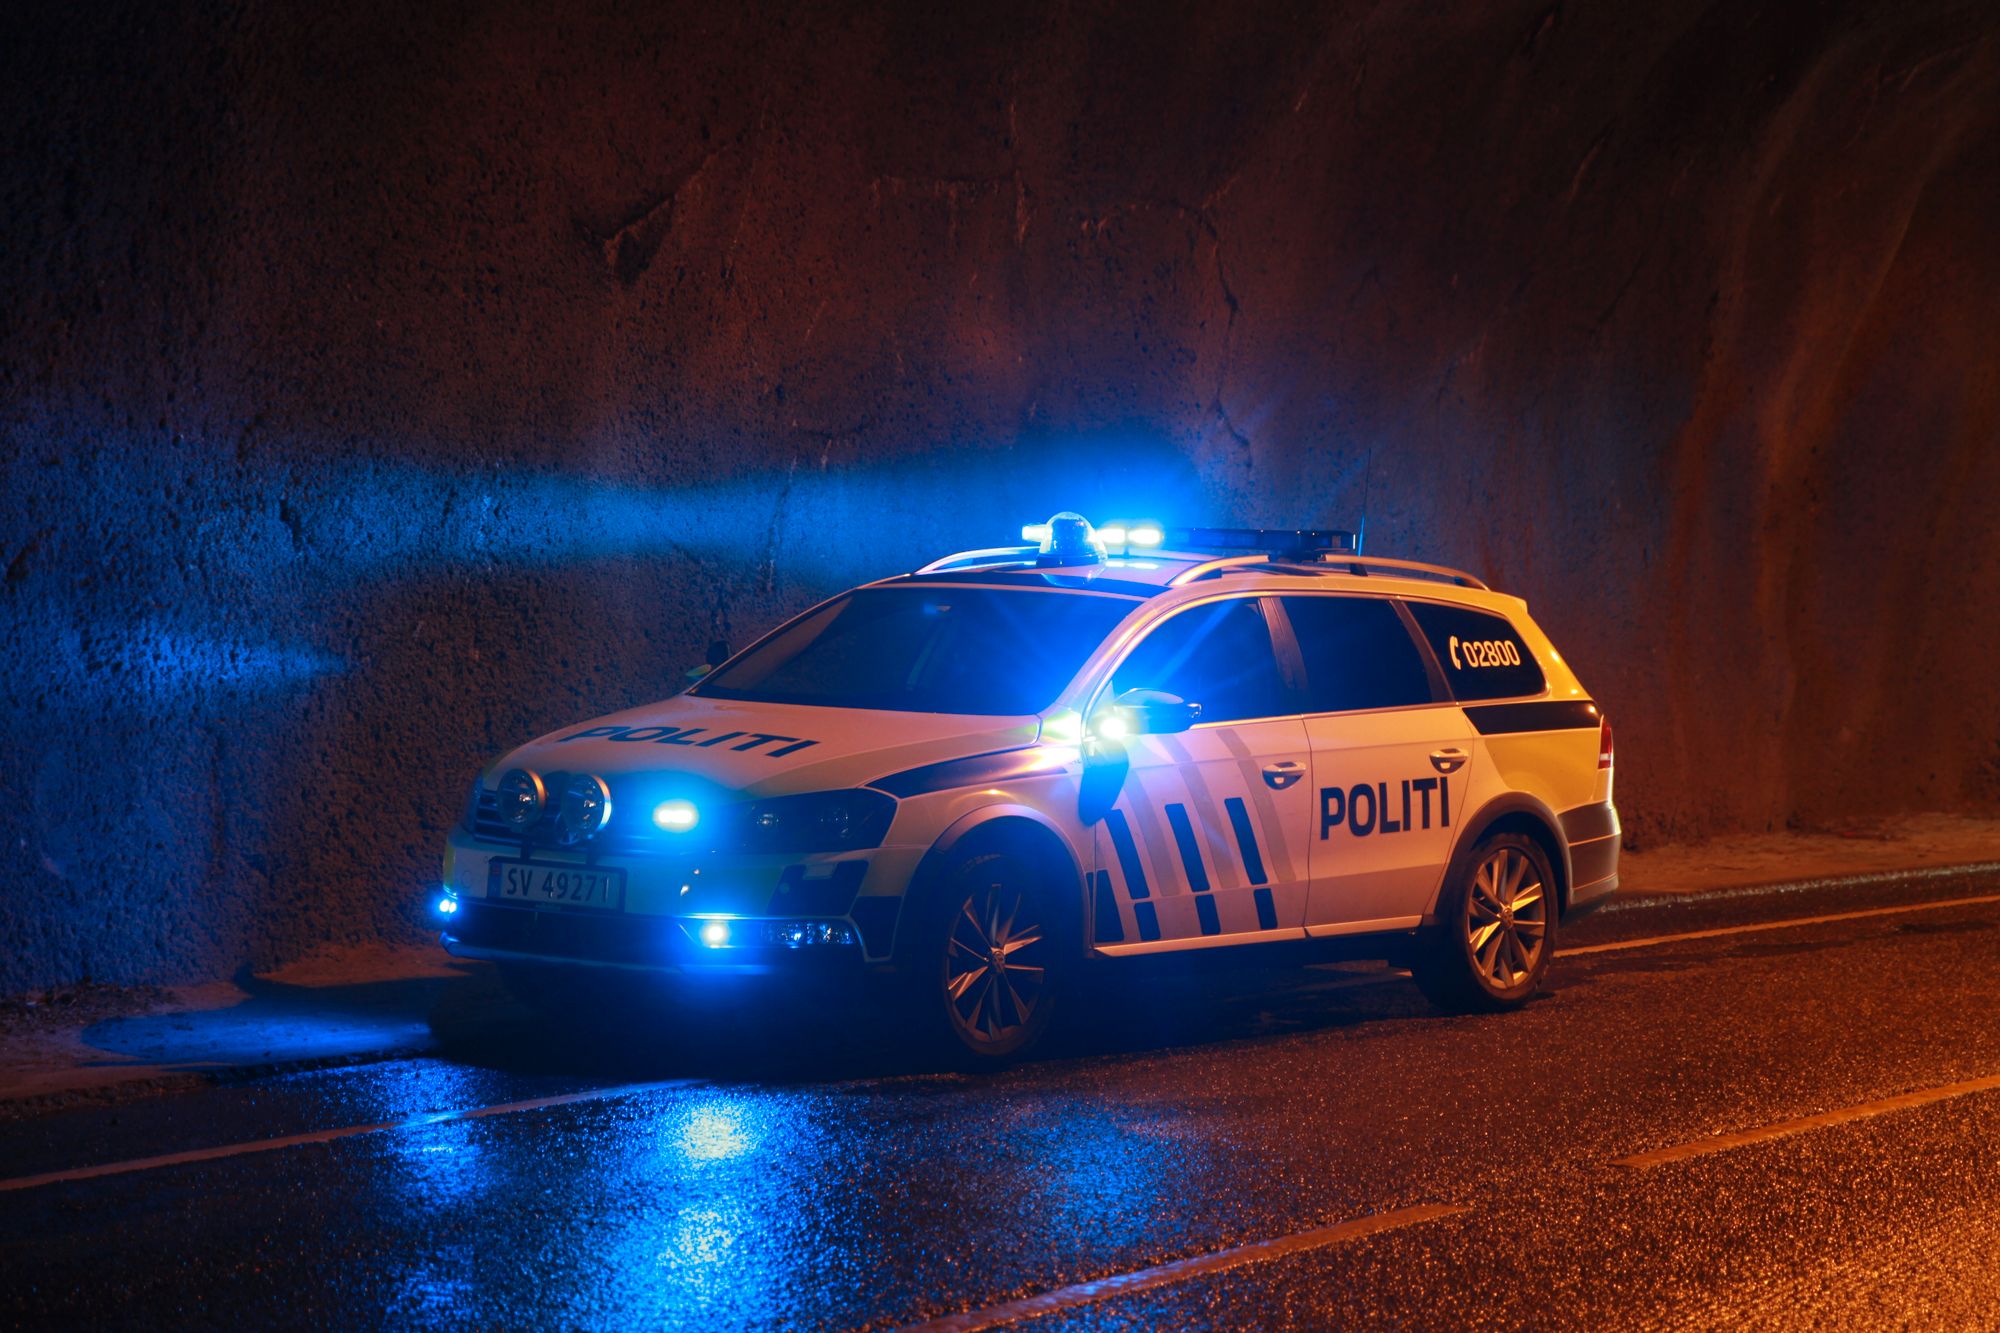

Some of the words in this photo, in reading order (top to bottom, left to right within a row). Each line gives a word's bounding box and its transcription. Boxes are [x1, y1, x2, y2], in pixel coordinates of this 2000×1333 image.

[1462, 640, 1521, 668] 02800
[558, 726, 822, 758] POLITI
[1320, 776, 1450, 841] POLITI
[507, 868, 532, 896] SV
[542, 871, 608, 903] 49271
